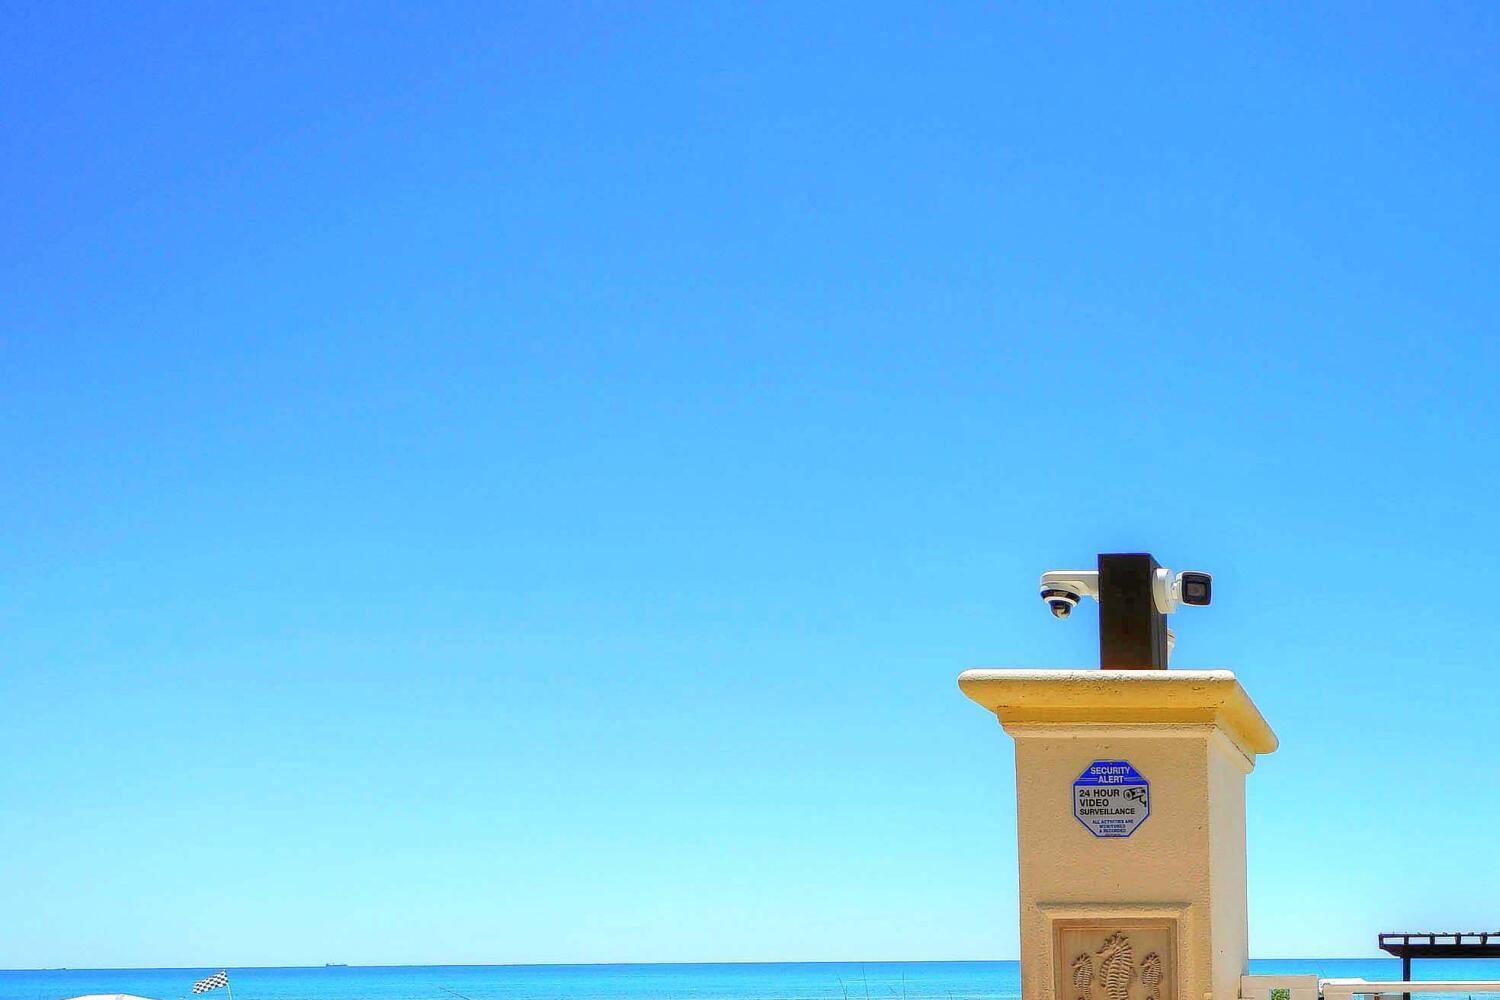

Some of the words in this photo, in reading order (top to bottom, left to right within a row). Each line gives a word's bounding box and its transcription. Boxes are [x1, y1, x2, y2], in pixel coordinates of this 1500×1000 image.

[1090, 766, 1130, 775] SECURITY
[1098, 776, 1124, 784] ALERT
[1079, 789, 1090, 798] 24
[1093, 789, 1120, 797] HOUR
[1080, 799, 1109, 807] VIDEO
